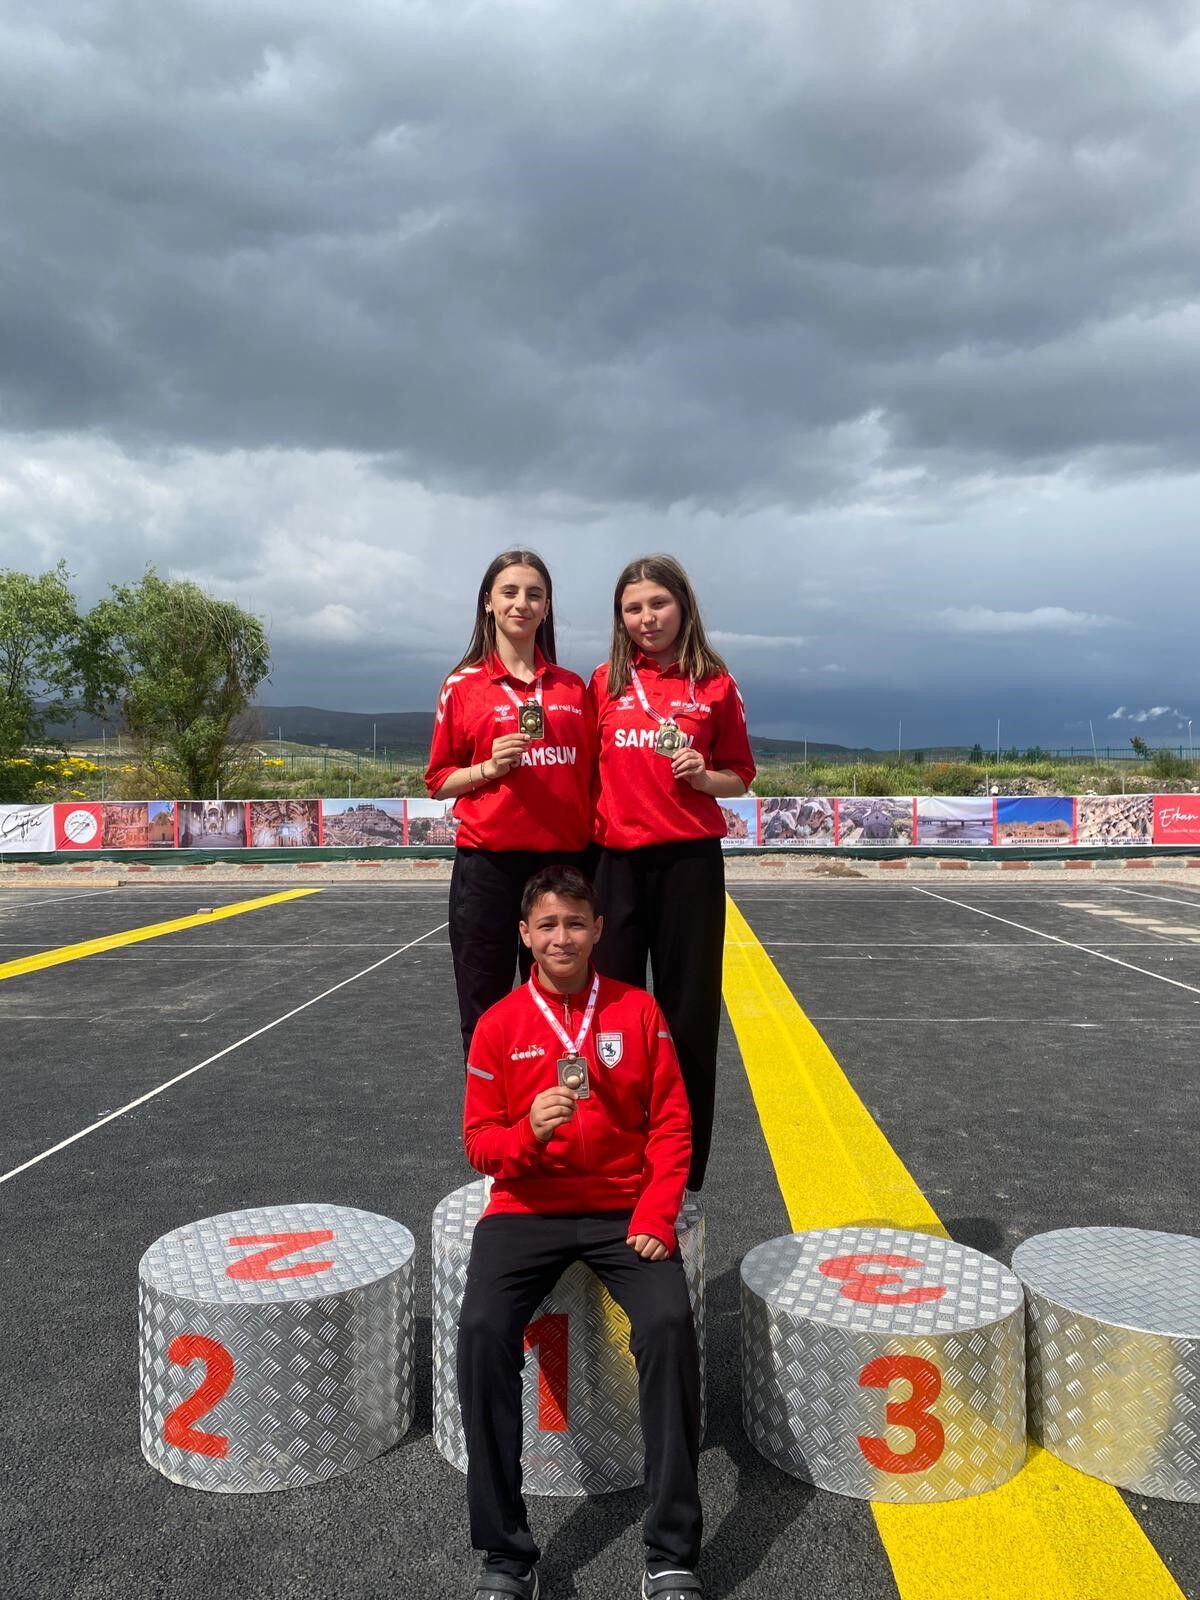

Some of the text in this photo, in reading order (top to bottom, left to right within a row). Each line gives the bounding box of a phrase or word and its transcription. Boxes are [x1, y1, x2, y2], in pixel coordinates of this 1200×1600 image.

[1159, 805, 1199, 828] Erkan
[164, 1333, 234, 1461] 2
[524, 1313, 569, 1432] 1
[857, 1354, 945, 1474] 3
